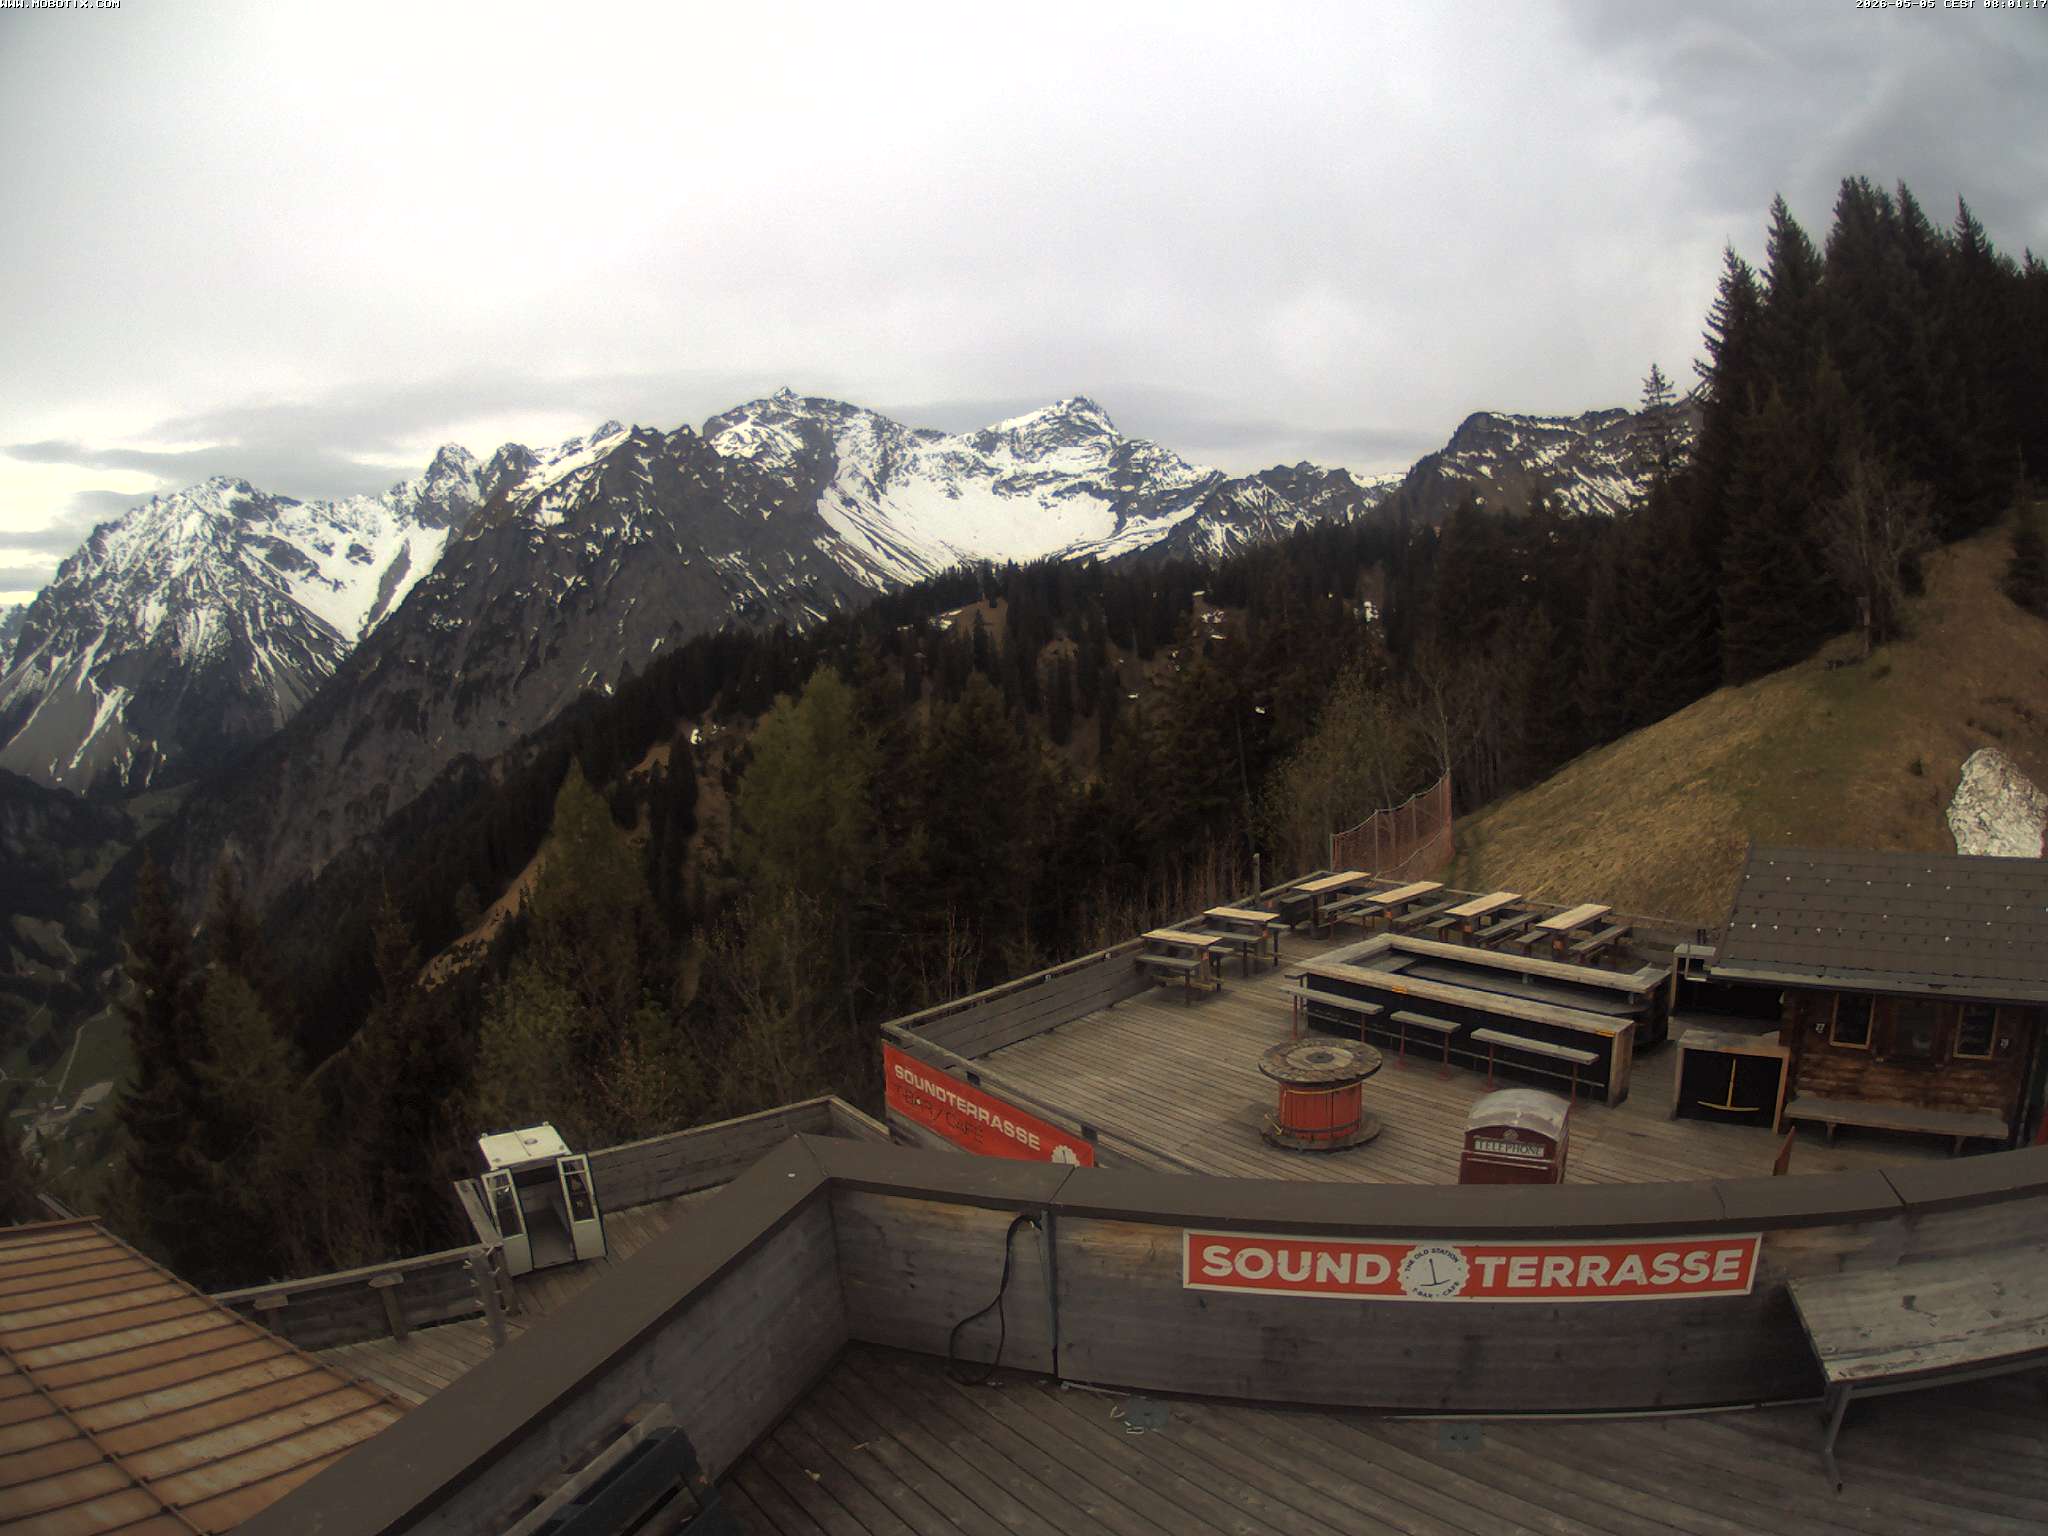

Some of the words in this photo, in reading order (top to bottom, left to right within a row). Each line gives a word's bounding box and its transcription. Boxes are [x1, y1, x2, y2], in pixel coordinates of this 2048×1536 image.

[894, 1064, 1041, 1151] SOUNDTERRASSE
[1475, 1139, 1543, 1156] TELEPHONE
[1201, 1245, 1392, 1285] SOUND
[1474, 1249, 1744, 1288] TERRASSE
[1404, 1259, 1415, 1272] THE
[1414, 1249, 1430, 1260] OLD
[1431, 1247, 1460, 1263] STATION
